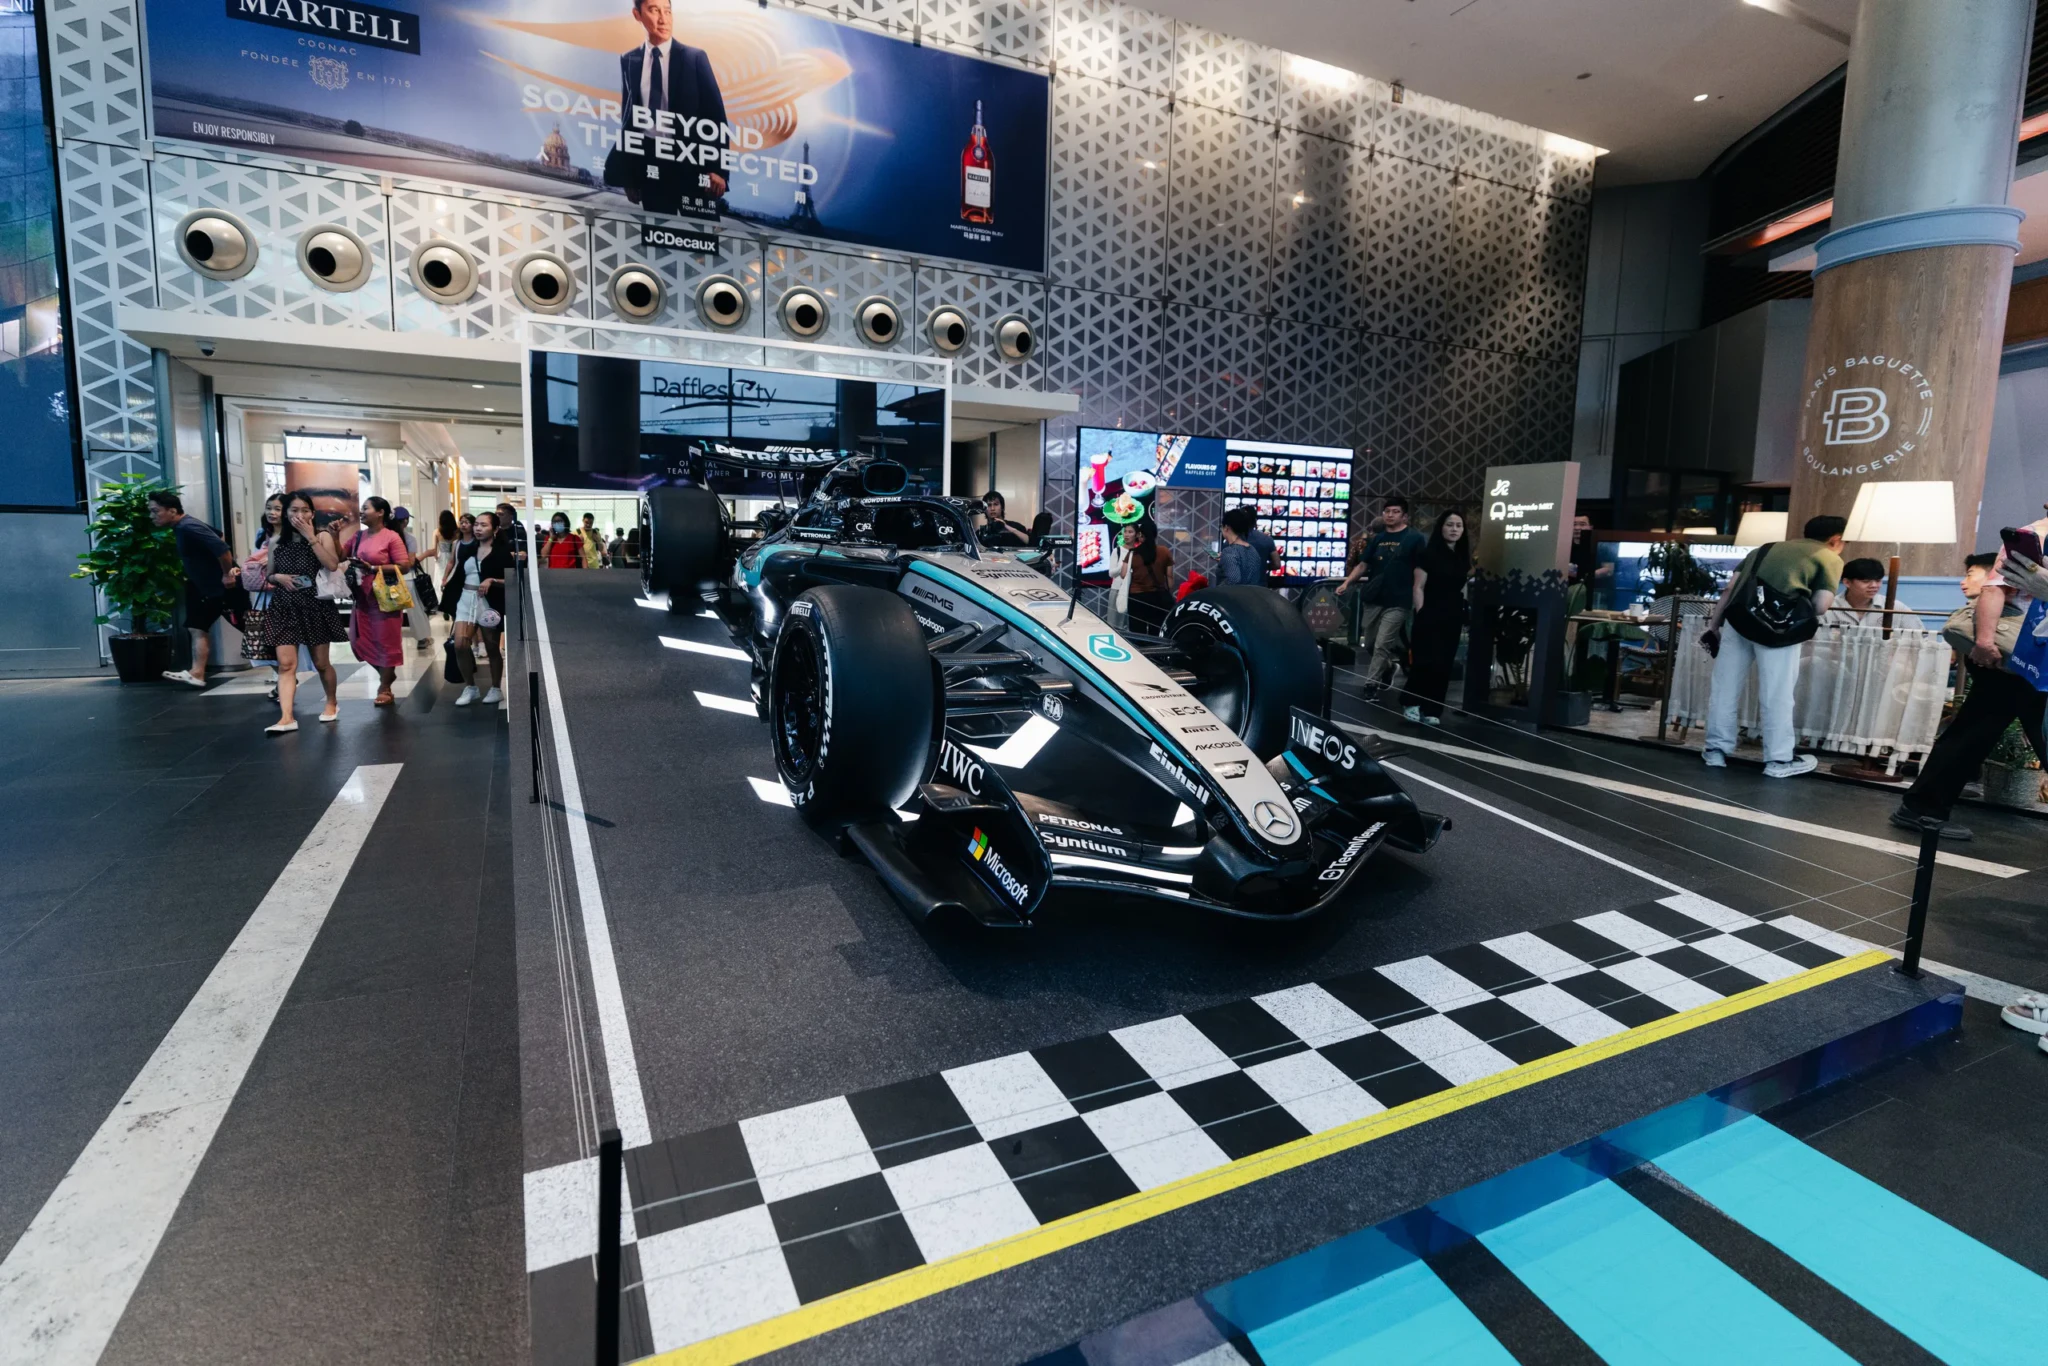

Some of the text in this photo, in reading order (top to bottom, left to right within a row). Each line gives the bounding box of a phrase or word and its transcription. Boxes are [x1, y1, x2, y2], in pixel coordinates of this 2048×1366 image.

[239, 0, 409, 44] MARTELL
[298, 38, 357, 55] COGNAC
[241, 50, 299, 68] FONDÉE
[357, 72, 411, 88] EN 1715
[522, 83, 764, 150] SOAR BEYOND
[193, 122, 275, 145] ENJOY RESPONSIBLY
[579, 122, 818, 185] THE EXPECTED
[645, 230, 715, 251] JCDecaux
[950, 224, 972, 232] MARTELL
[972, 227, 991, 235] CORDON
[653, 376, 729, 399] Raffles
[1806, 355, 1933, 408] PARIS BAGUETTE
[1803, 441, 1916, 476] BOULANGERIE
[924, 592, 954, 611] AMG
[1187, 601, 1233, 635] ZERO
[1156, 706, 1207, 717] INEOS
[1180, 725, 1219, 733] PIRELLI
[1290, 715, 1357, 770] INEOS
[940, 739, 985, 795] IWC
[1150, 742, 1210, 805] Einhell
[1039, 814, 1123, 835] PETRONAS
[1040, 831, 1126, 857] Syntium
[984, 847, 1029, 905] Microsoft
